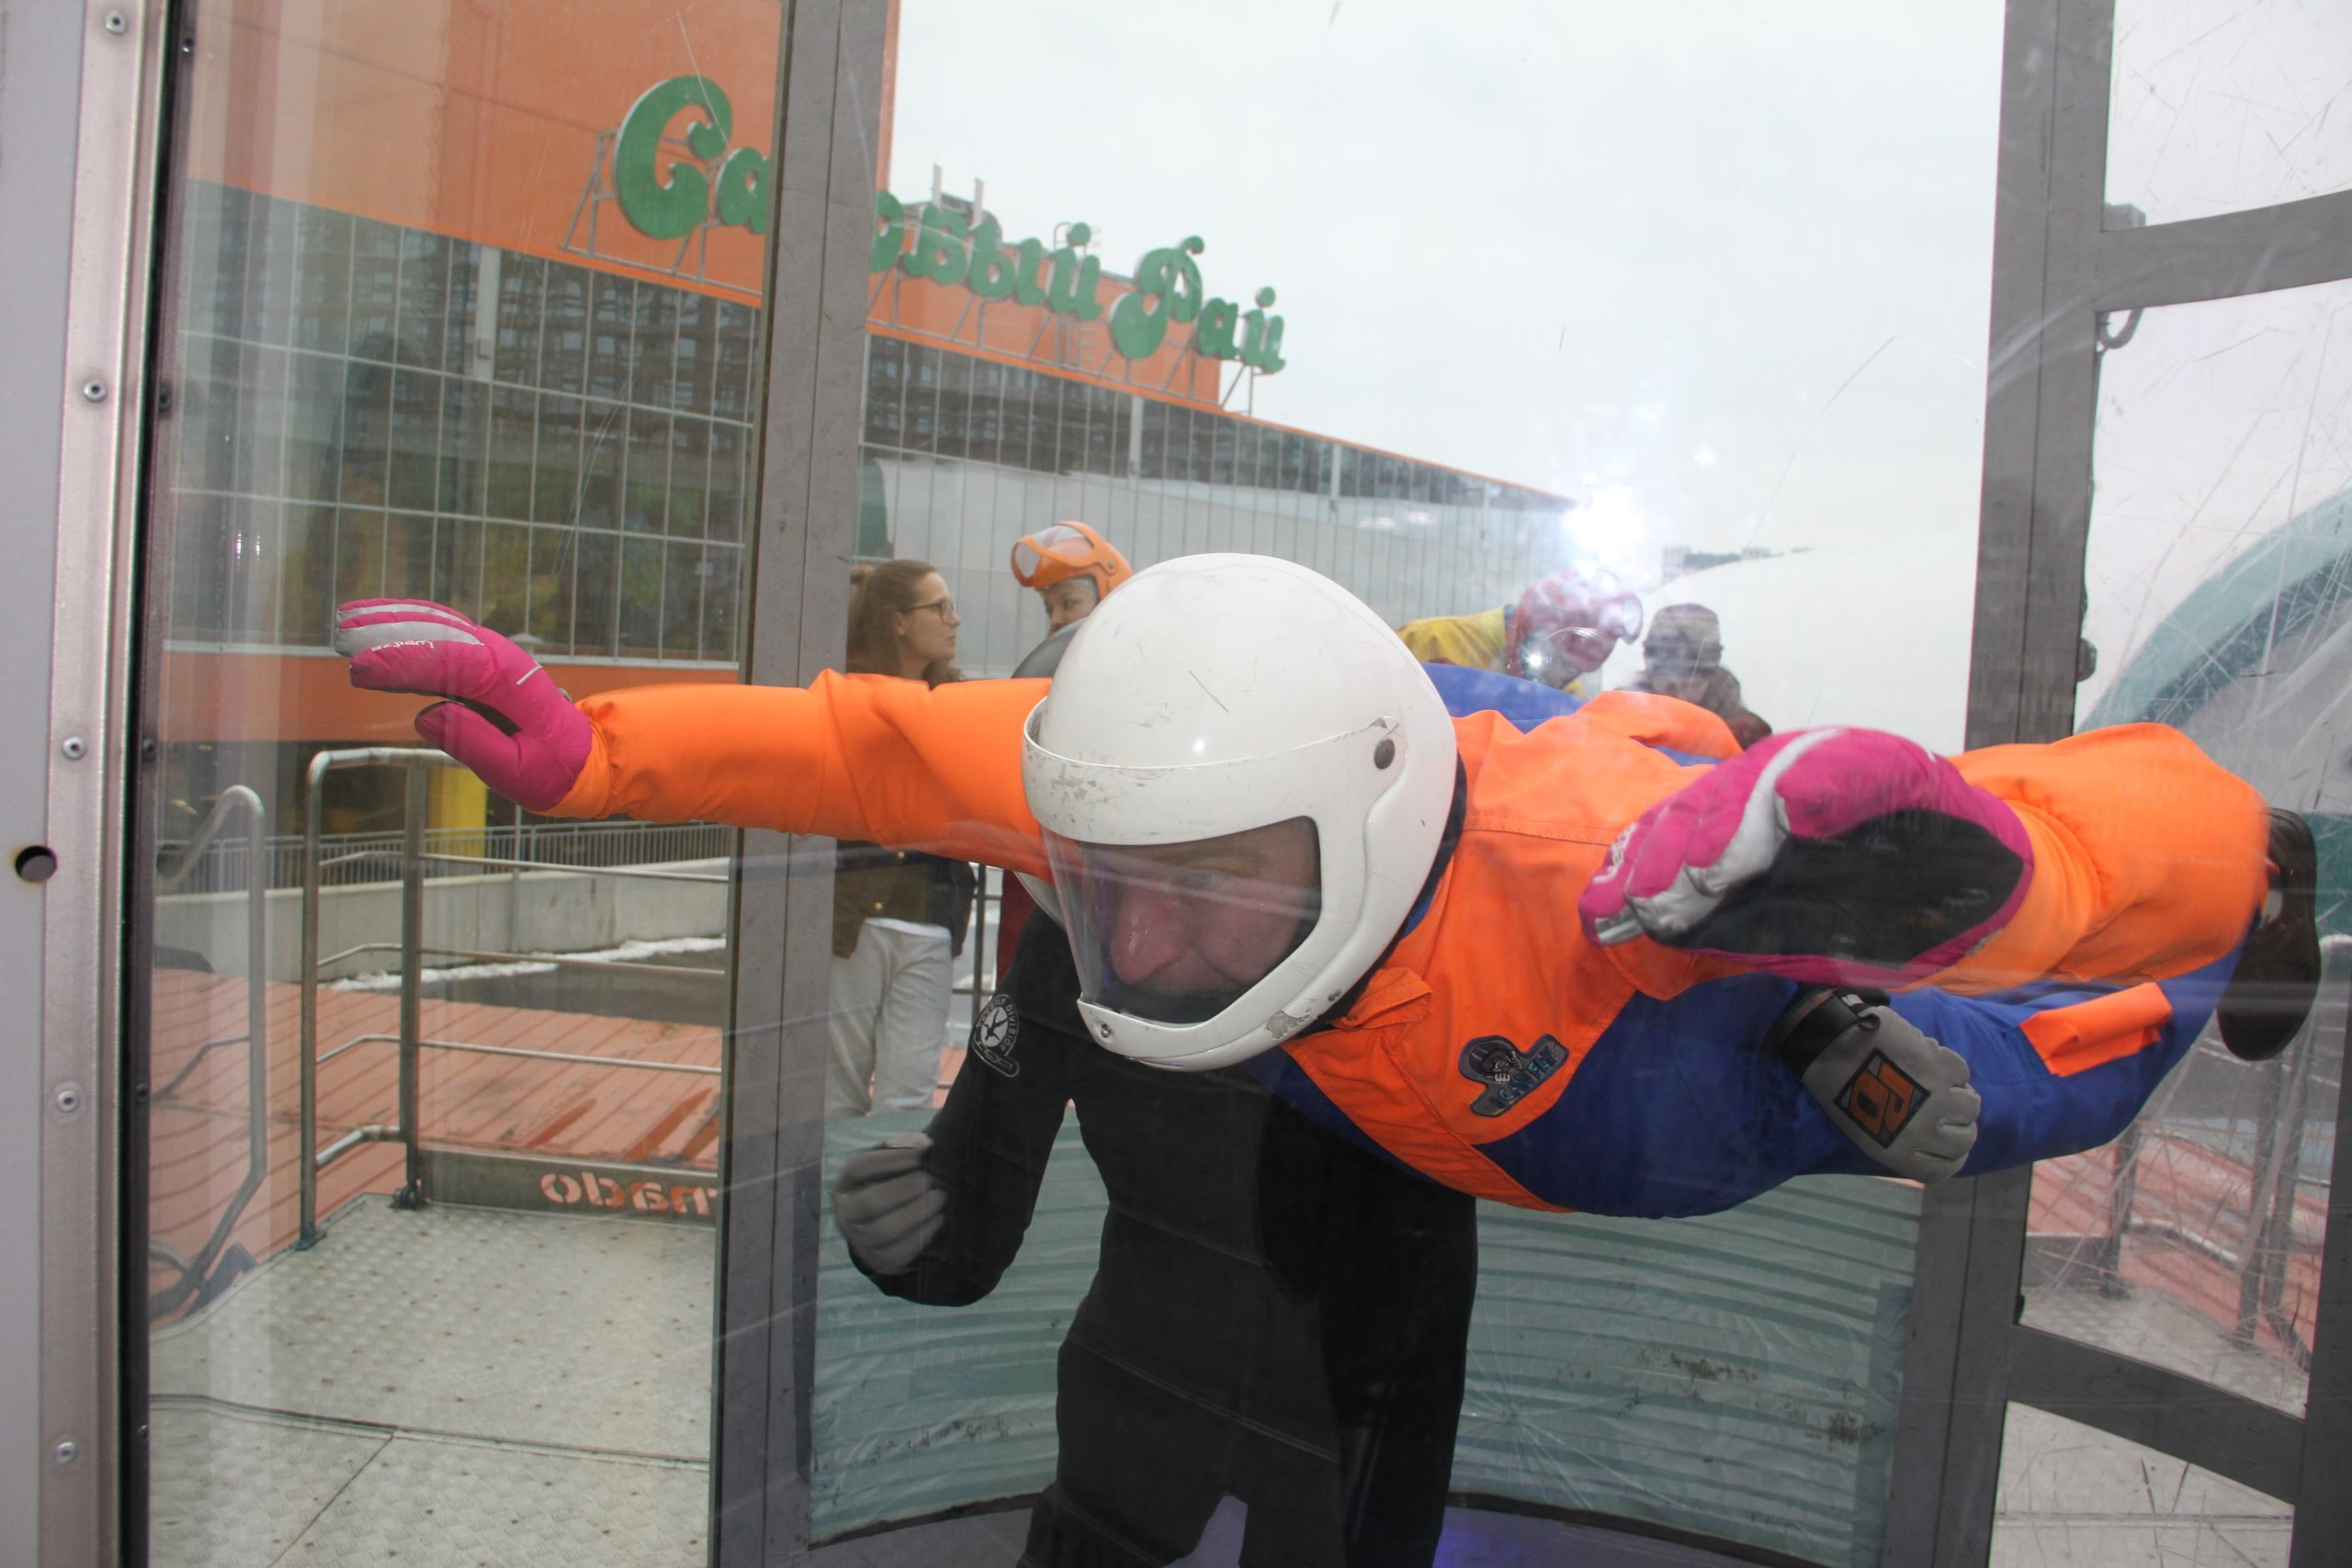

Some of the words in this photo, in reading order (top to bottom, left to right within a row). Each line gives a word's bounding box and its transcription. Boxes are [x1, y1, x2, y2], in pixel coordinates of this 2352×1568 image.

[616, 75, 1102, 320] Саовый
[1109, 235, 1286, 375] Рай
[1498, 1071, 1534, 1101] CAN
[1527, 1045, 1557, 1079] FLY
